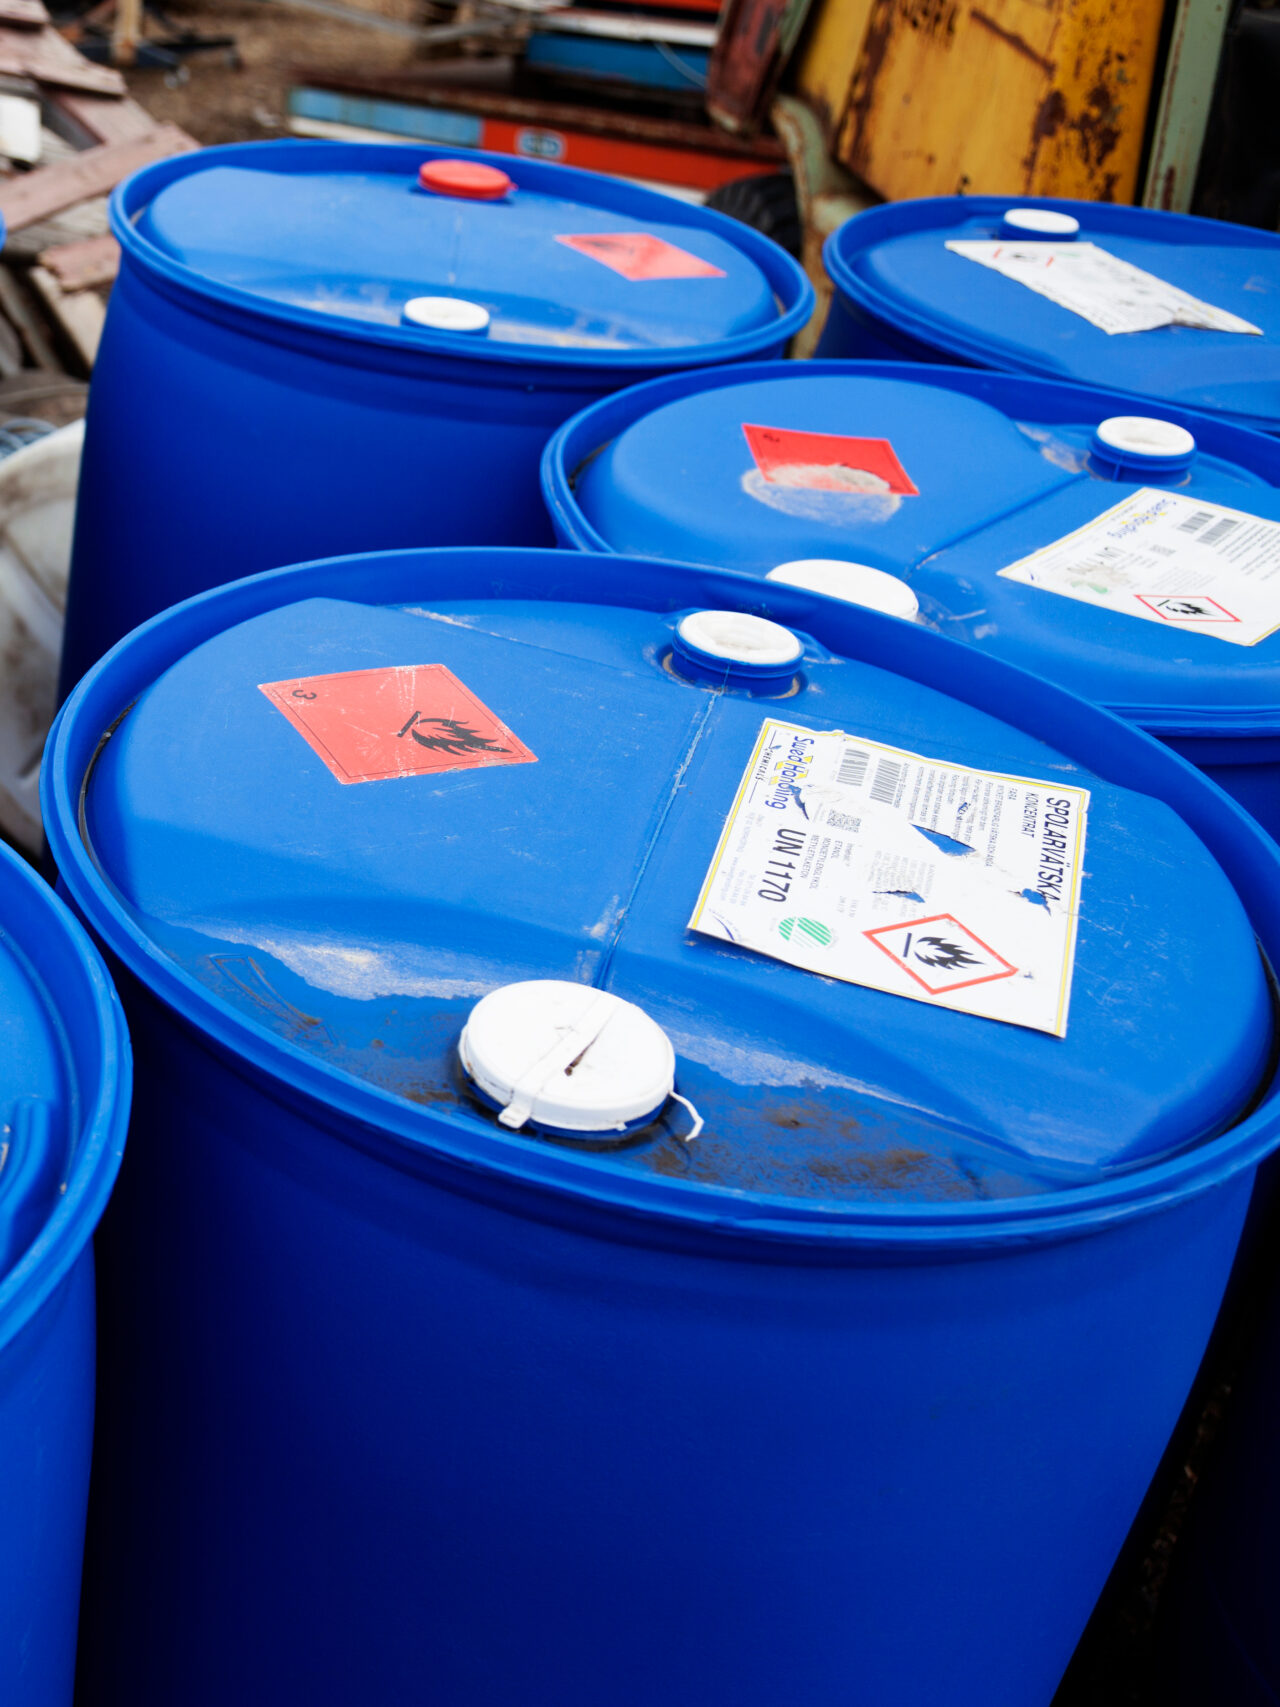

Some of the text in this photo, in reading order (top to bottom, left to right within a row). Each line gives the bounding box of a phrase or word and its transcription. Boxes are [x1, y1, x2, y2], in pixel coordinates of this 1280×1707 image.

[291, 689, 318, 701] 3
[788, 736, 814, 764] Swed
[1023, 793, 1038, 838] KONCENTRAT
[758, 829, 806, 902] UN 1170
[1034, 798, 1070, 901] SPOLARVÄTSKA
